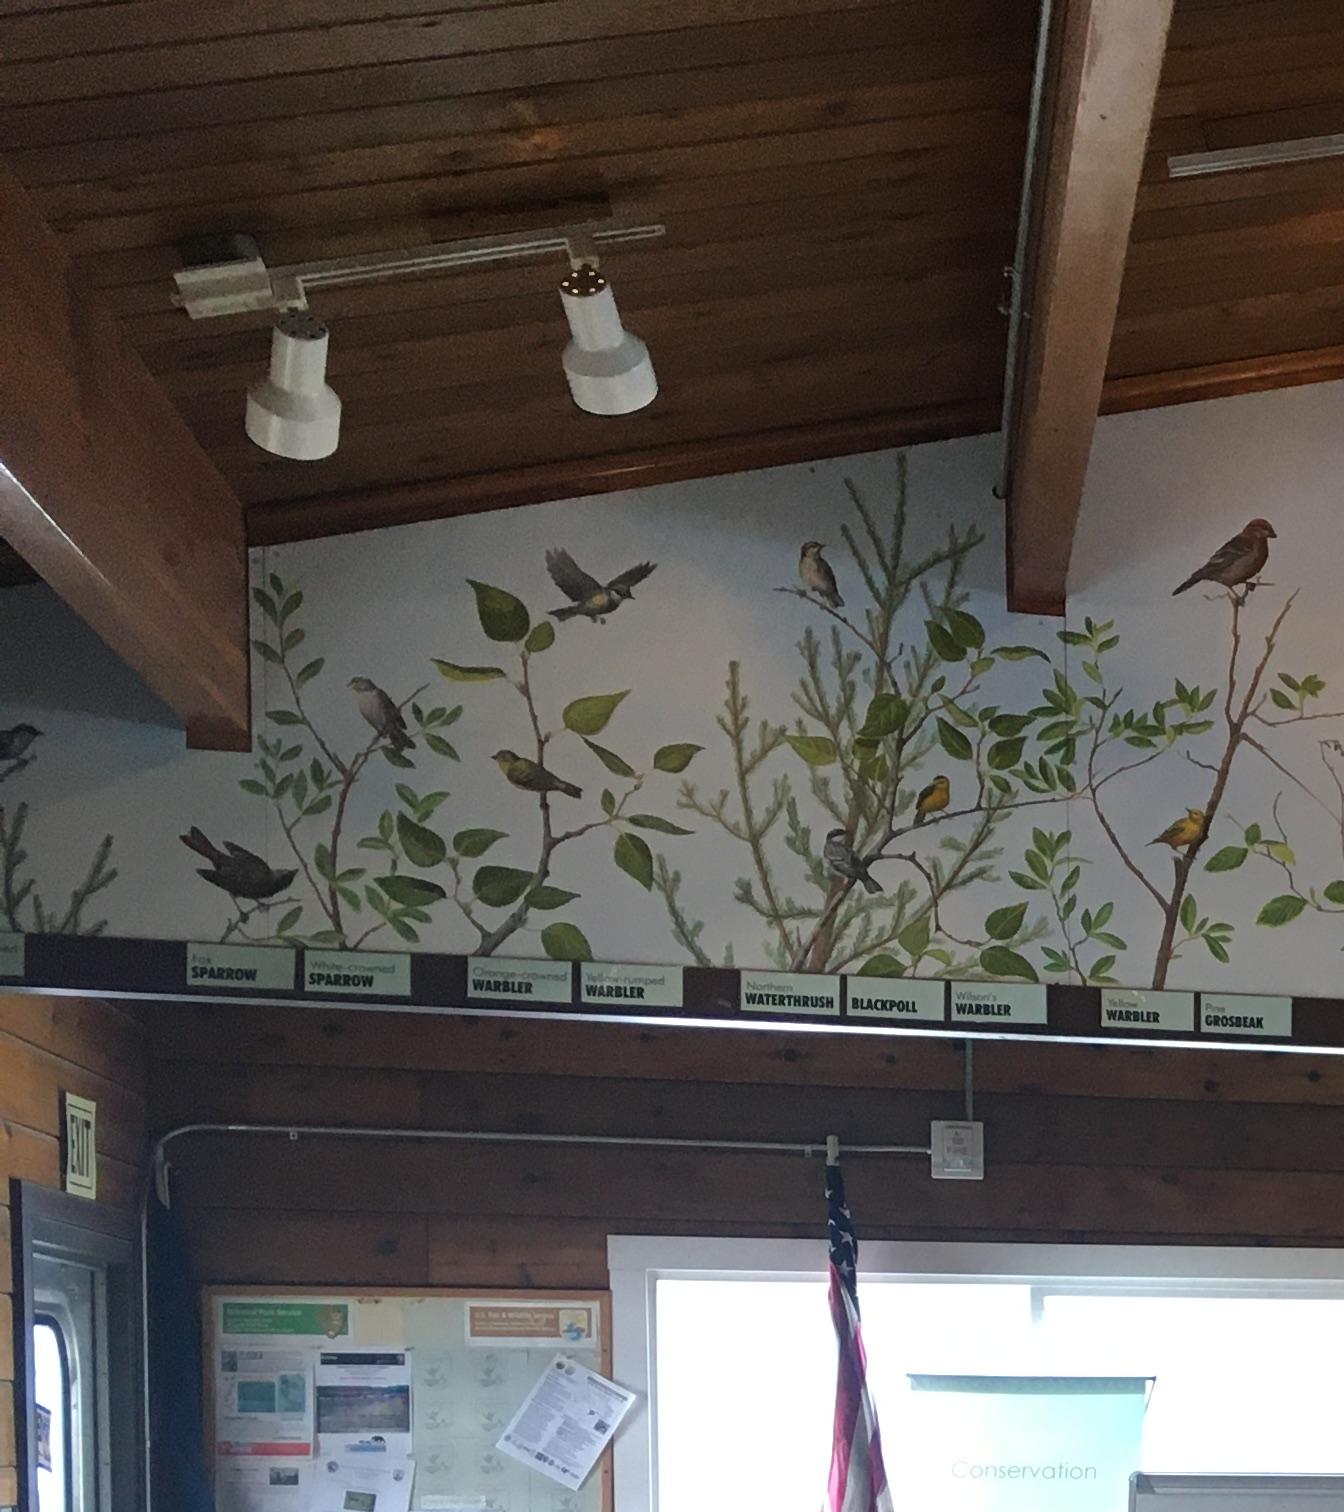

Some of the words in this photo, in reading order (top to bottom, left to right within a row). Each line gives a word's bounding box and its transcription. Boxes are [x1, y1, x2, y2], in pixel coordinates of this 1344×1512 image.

[191, 966, 257, 982] SPARROW
[310, 959, 396, 974] White-crowned
[472, 966, 568, 983] Orange-crowned
[309, 972, 374, 988] SPARROW
[472, 978, 533, 994] WARBLER
[746, 981, 793, 993] Northern
[586, 984, 645, 1000] WARBLER
[745, 992, 834, 1009] WATERTHRUSH
[851, 997, 918, 1013] BLACKPOLL
[955, 1002, 1011, 1017] WARBLER
[1106, 1009, 1160, 1023] WARBLER
[1205, 1015, 1264, 1029] GROSBEAK
[70, 1113, 92, 1178] EXIT
[951, 1461, 1097, 1480] Conservation
